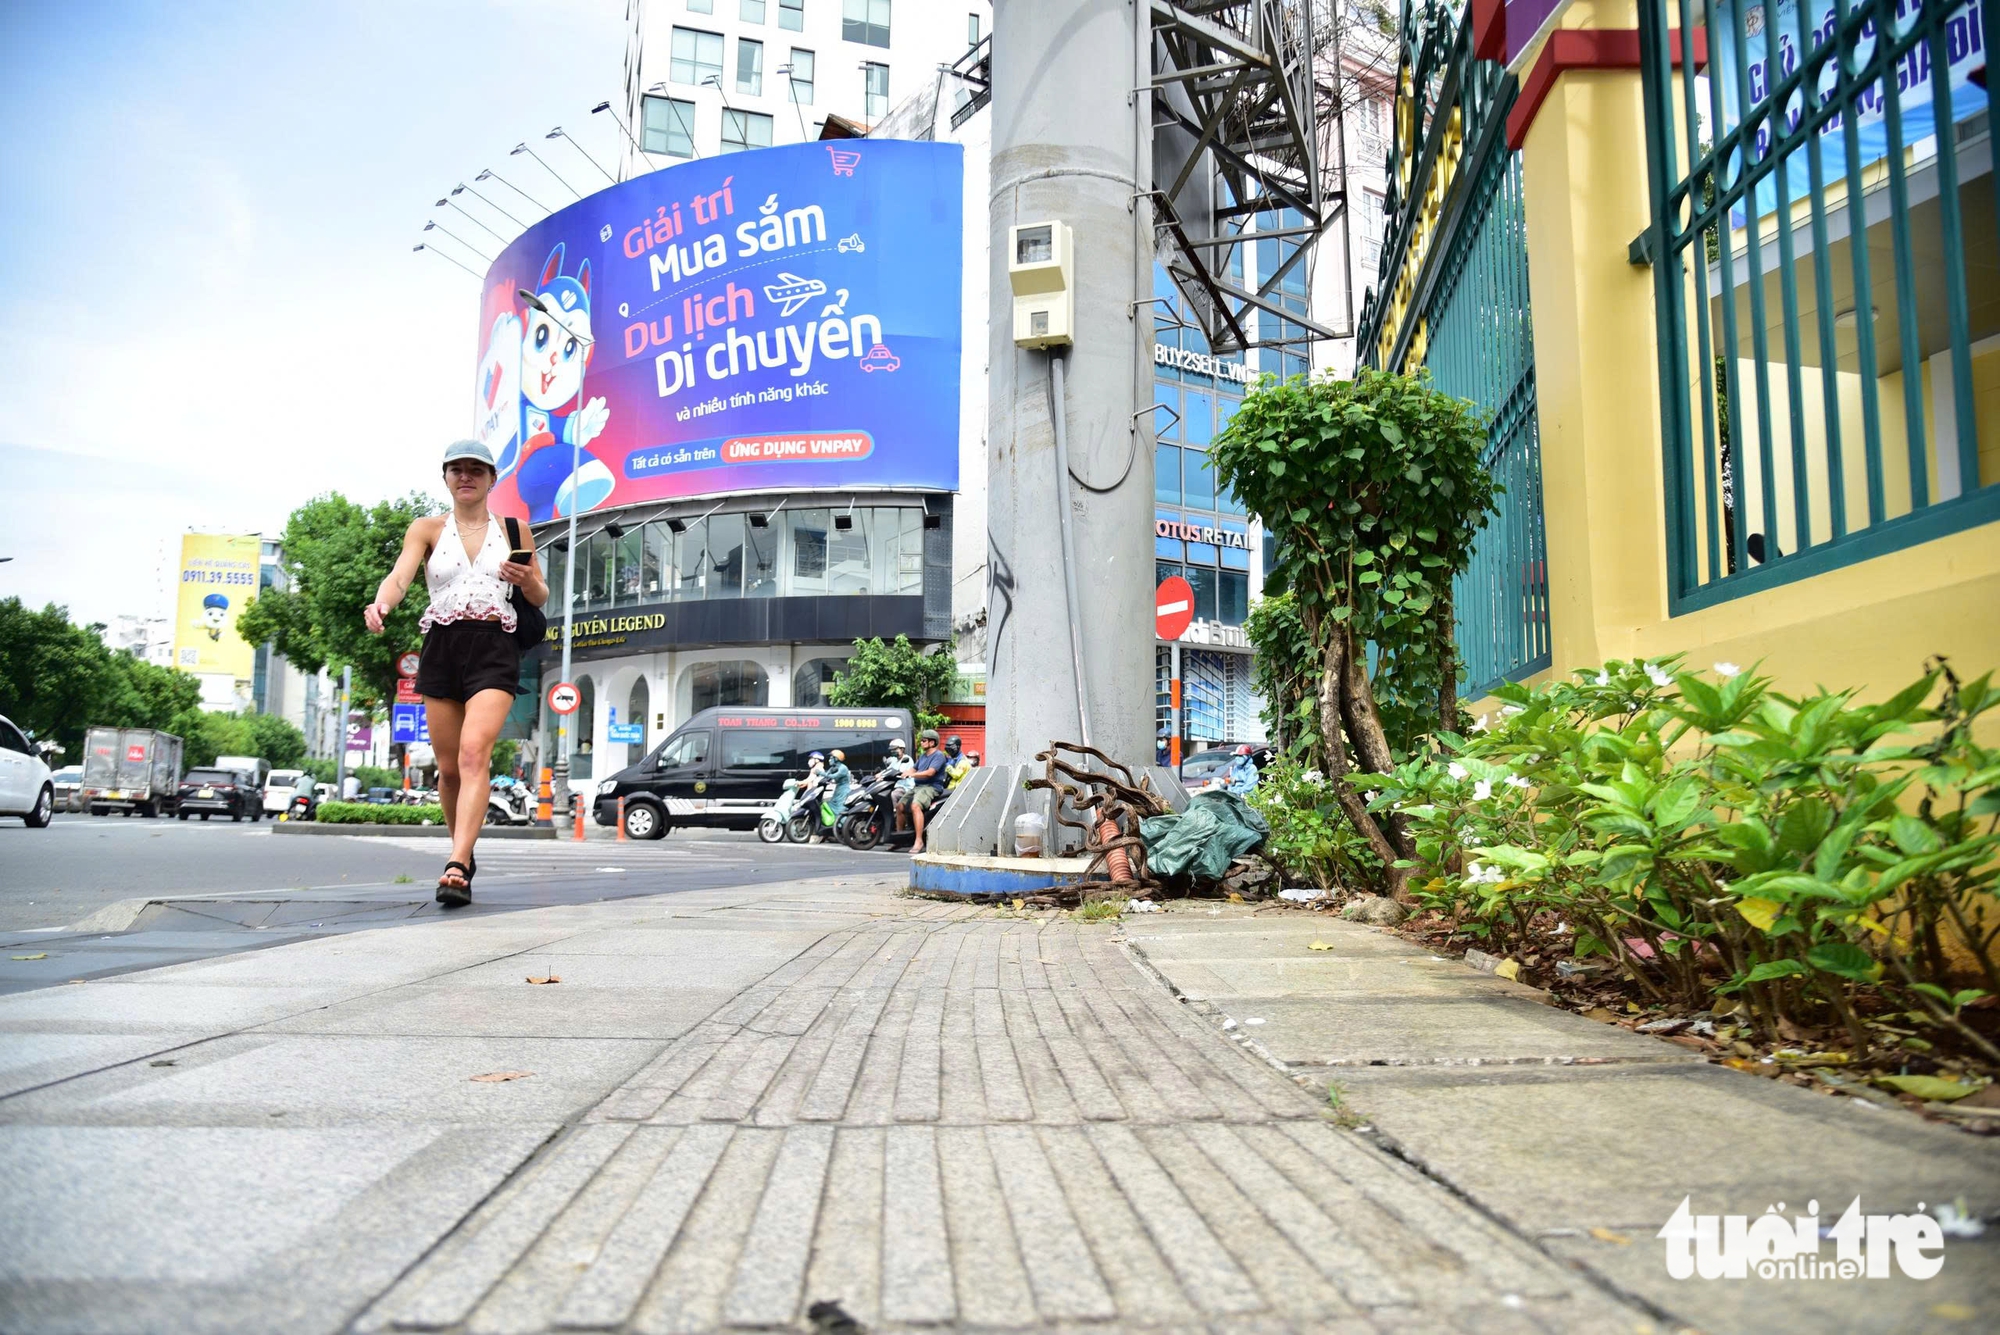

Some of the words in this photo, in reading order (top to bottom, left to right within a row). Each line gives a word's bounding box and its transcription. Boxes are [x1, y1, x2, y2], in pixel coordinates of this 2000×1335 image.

[623, 202, 683, 259] Giải
[690, 175, 734, 226] trí
[649, 233, 727, 292] Mua
[736, 193, 826, 258] sắm
[624, 315, 673, 359] Du
[683, 282, 754, 341] lịch
[655, 342, 696, 398] Di
[705, 288, 882, 380] chuyển
[1155, 344, 1247, 383] BUY2SELL.VN
[676, 404, 691, 422] và
[693, 396, 727, 418] nhiều
[729, 389, 756, 409] tính
[758, 384, 793, 403] năng
[795, 380, 829, 397] khác
[693, 448, 716, 461] trên
[729, 440, 760, 458] ỨNG
[763, 440, 806, 458] DỤNG
[810, 439, 863, 453] VNPAY
[1155, 520, 1200, 541] OTUS
[183, 570, 254, 585] 0911.39.5555
[611, 613, 665, 633] LEGEND
